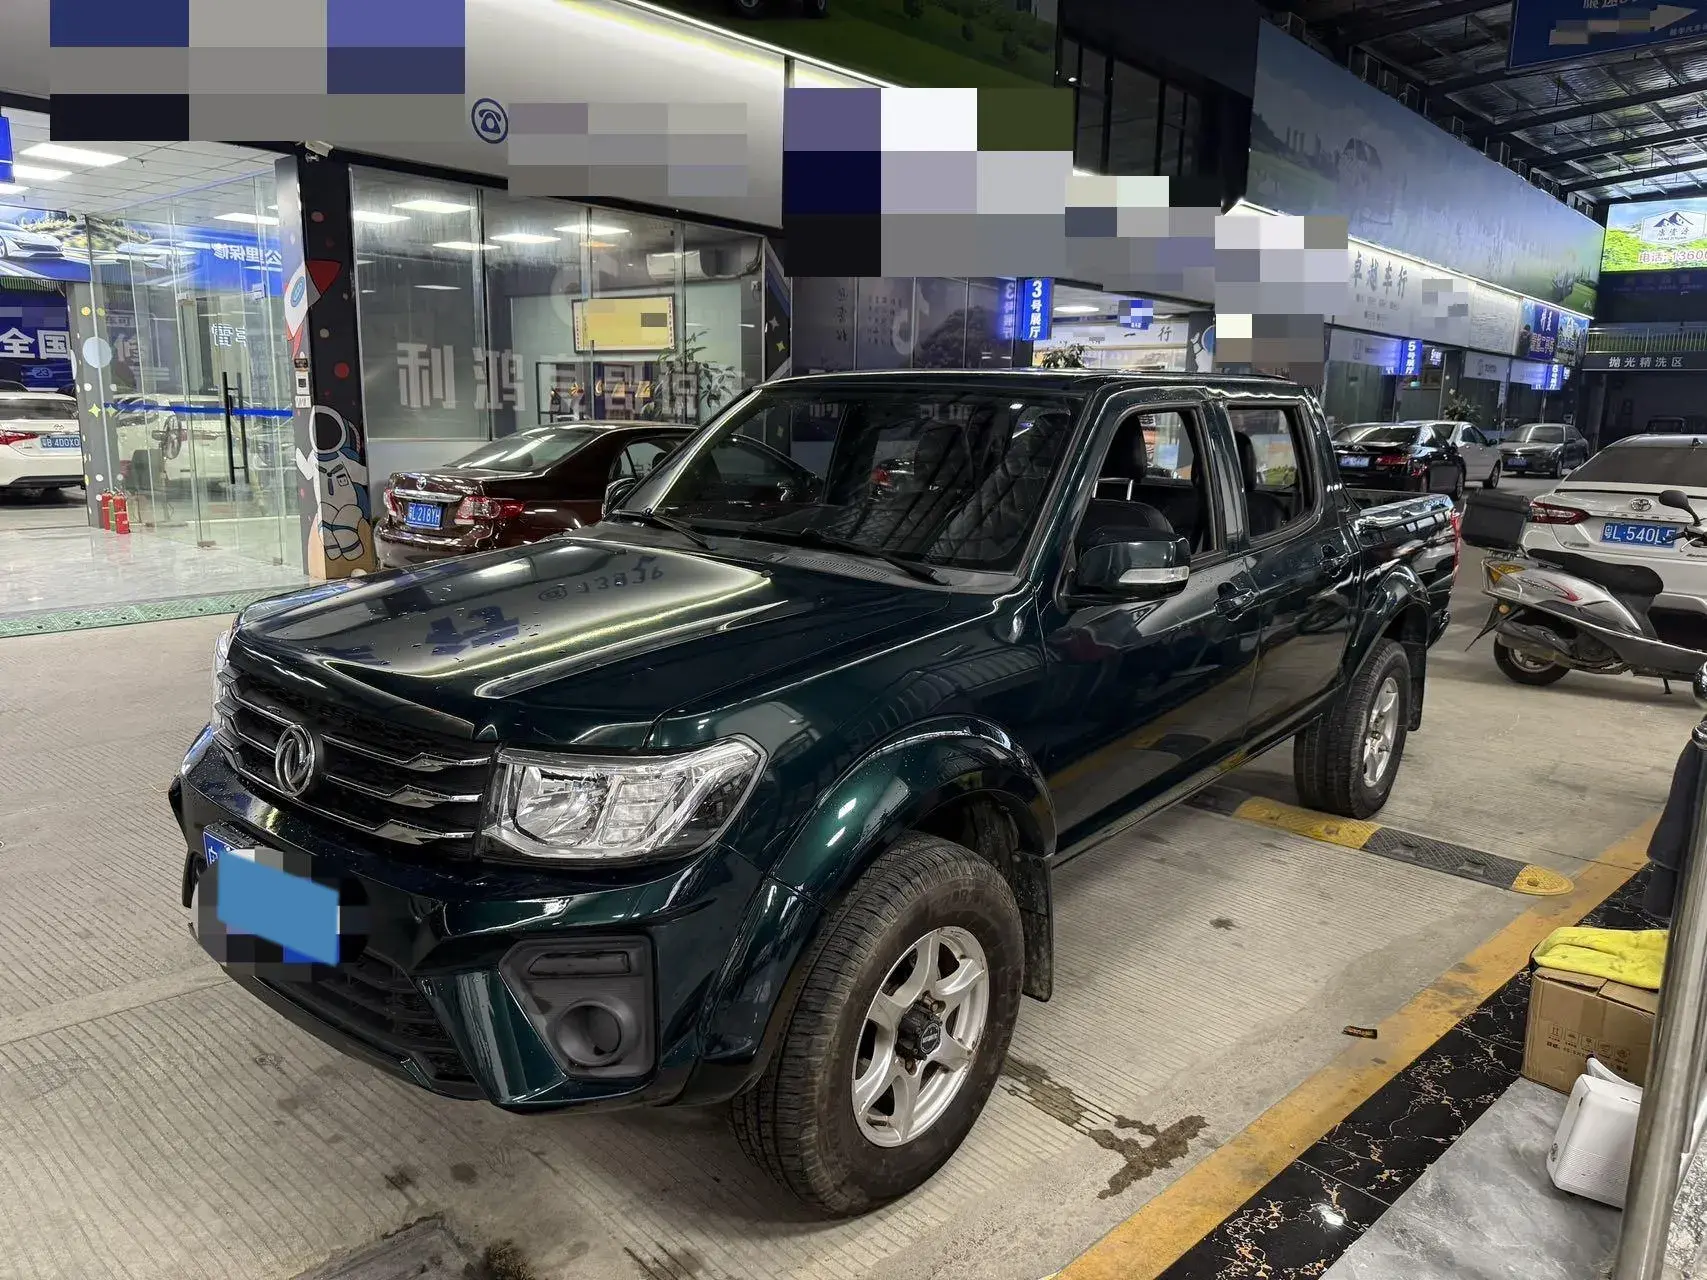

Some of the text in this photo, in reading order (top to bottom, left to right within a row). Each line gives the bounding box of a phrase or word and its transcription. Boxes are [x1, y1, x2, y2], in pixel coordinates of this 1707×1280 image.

[1030, 279, 1043, 339] 3号展厅
[0, 327, 70, 359] 全国
[1608, 356, 1683, 368] 抛光精洗区
